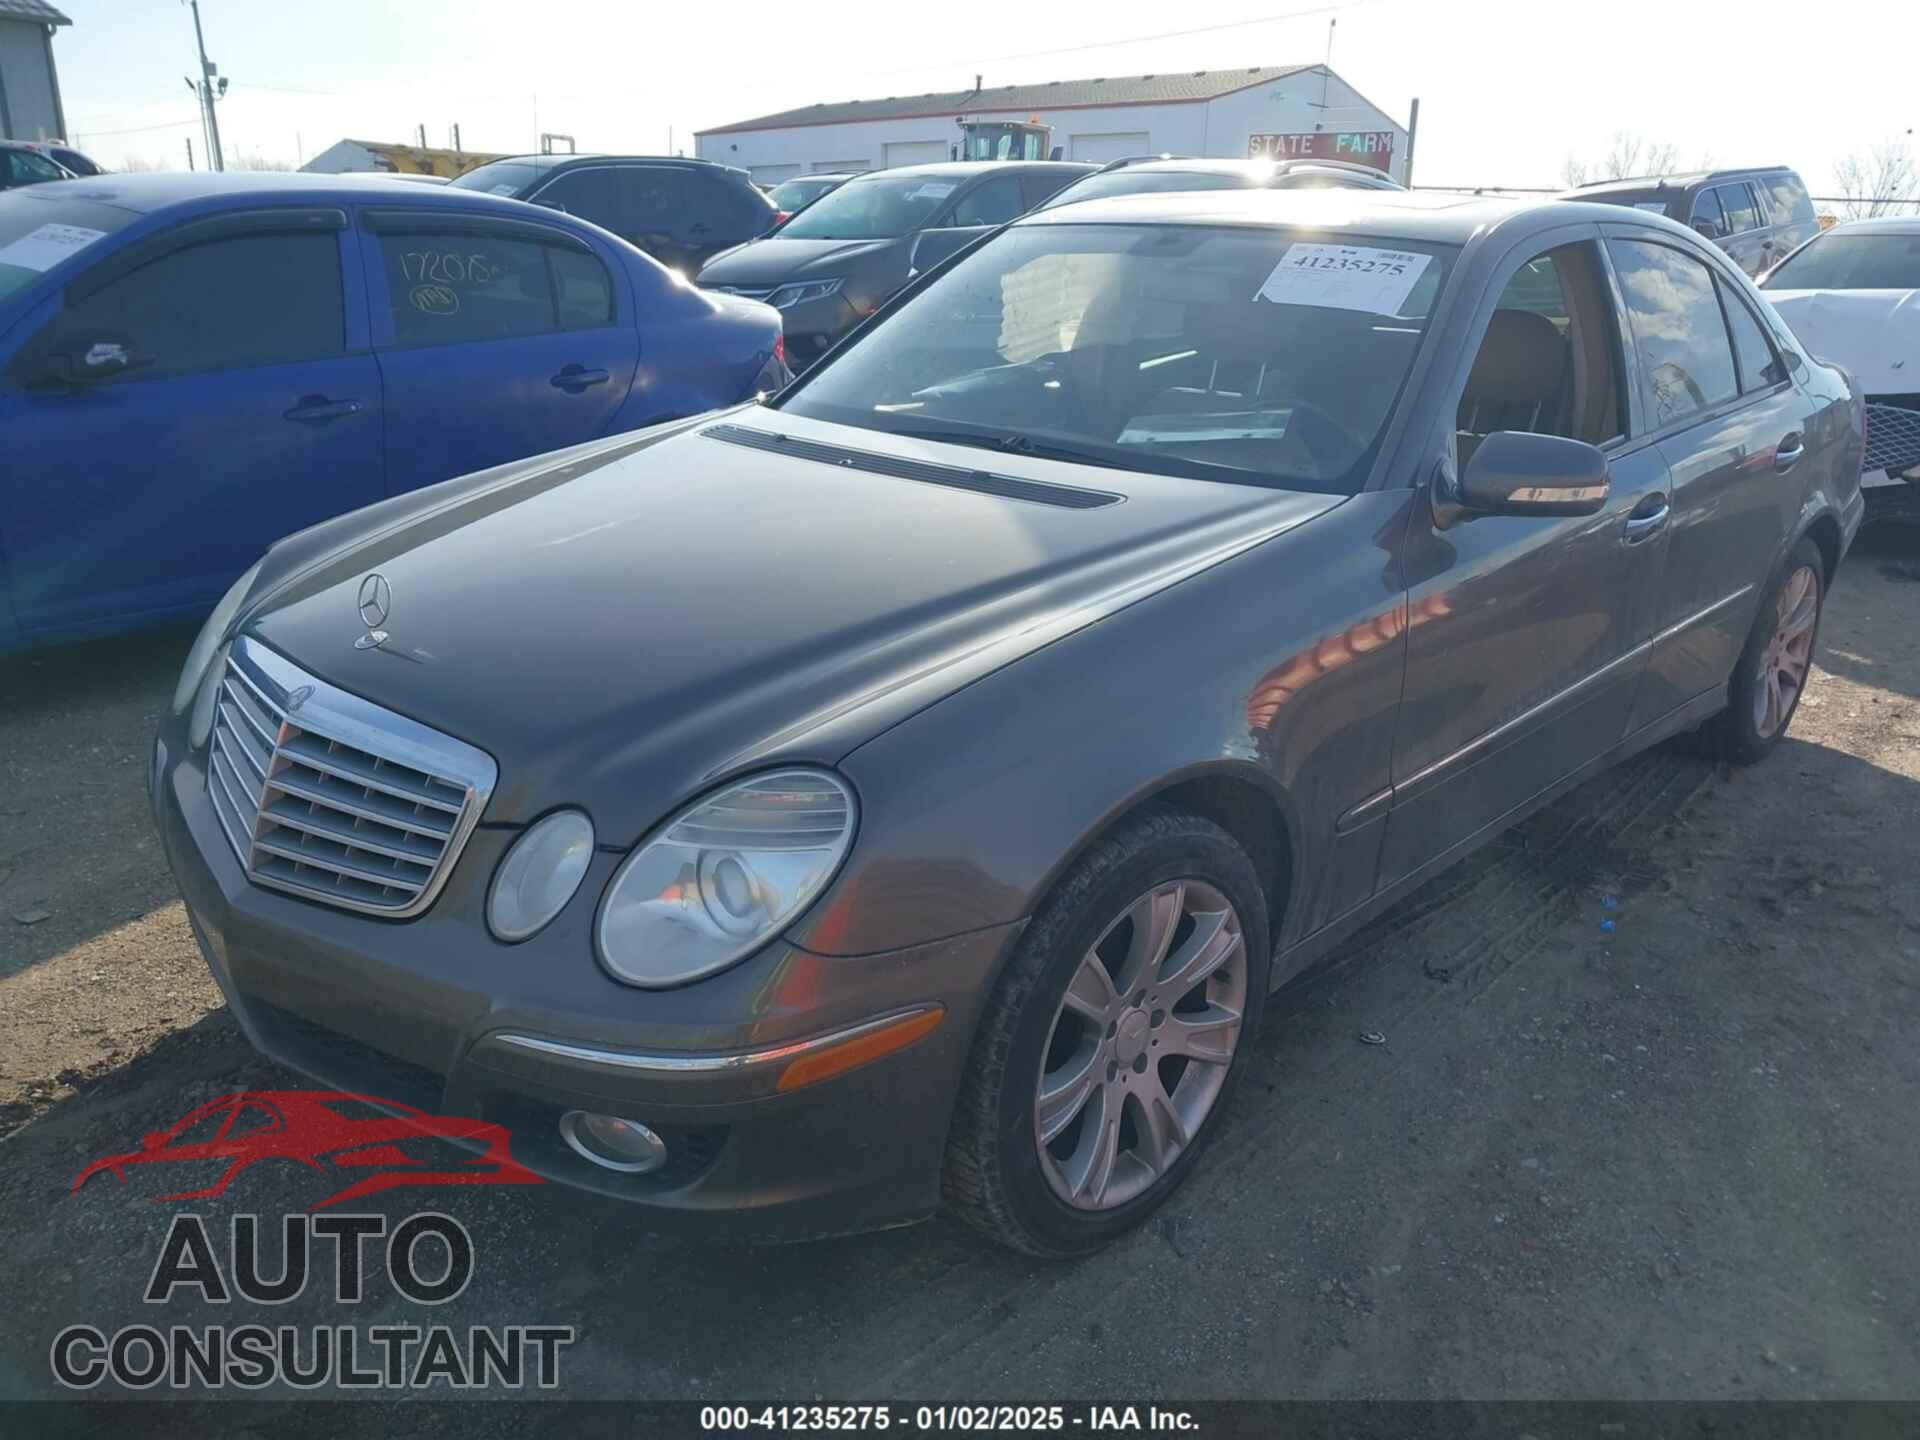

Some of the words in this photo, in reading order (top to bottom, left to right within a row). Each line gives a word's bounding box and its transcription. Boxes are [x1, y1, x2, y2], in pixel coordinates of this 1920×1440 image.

[1250, 135, 1314, 154] STATE
[1336, 133, 1392, 153] FARM
[1294, 256, 1406, 276] 41235275
